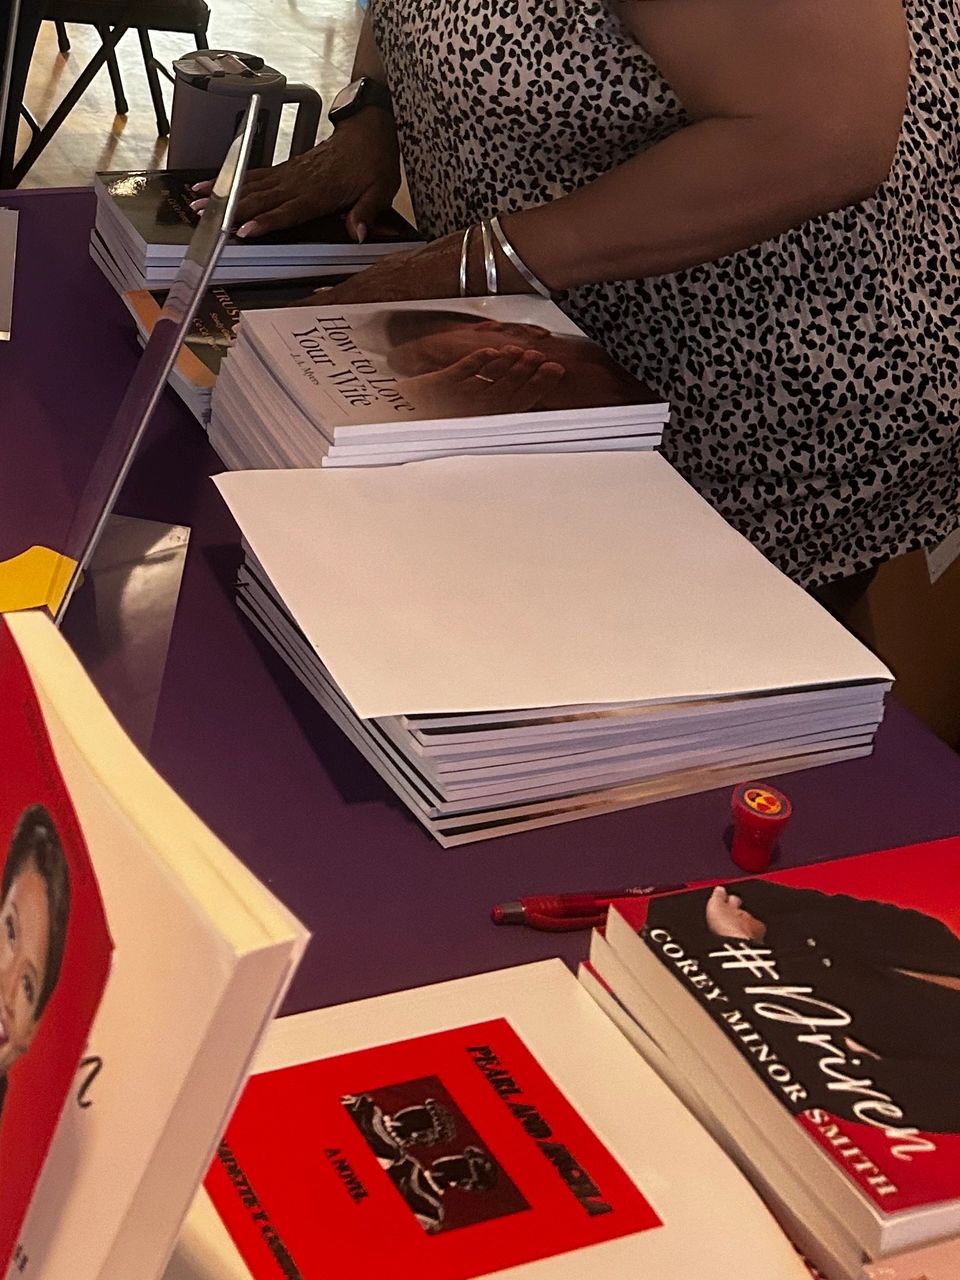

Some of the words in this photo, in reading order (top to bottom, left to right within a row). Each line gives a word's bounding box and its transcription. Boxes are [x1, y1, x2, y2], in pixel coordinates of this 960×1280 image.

[211, 287, 240, 321] TRUST
[290, 326, 336, 369] Your
[326, 367, 379, 409] Wife
[300, 368, 321, 386] Myers
[315, 315, 360, 354] How
[349, 359, 377, 376] to
[365, 378, 417, 413] Love
[648, 927, 729, 1003] COREY
[720, 1008, 809, 1105] MINOR
[803, 1106, 900, 1200] SMITH
[707, 939, 940, 1158] #Driven
[465, 1045, 524, 1100] PEARL
[505, 1103, 553, 1141] AND
[323, 1149, 343, 1160] A
[331, 1157, 369, 1206] NOVEL
